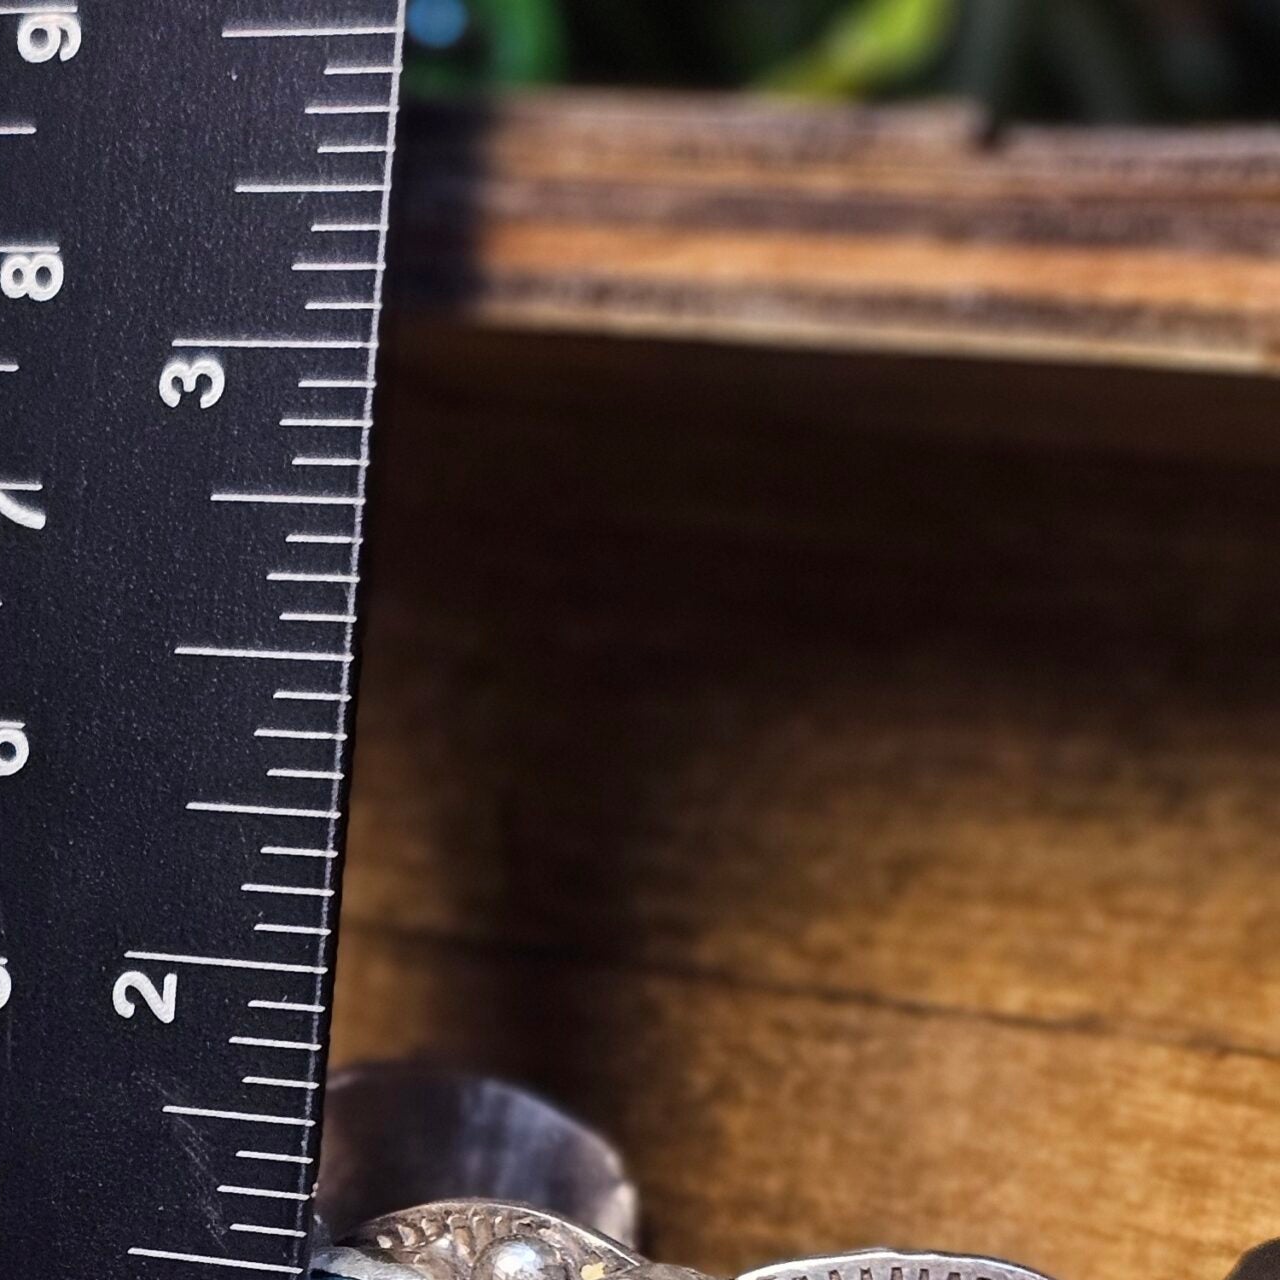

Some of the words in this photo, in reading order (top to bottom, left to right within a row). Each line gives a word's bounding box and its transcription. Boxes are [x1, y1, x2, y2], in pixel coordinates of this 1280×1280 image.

[17, 13, 82, 62] 9
[0, 253, 64, 302] 8
[159, 354, 225, 409] 3
[113, 970, 177, 1024] 2
